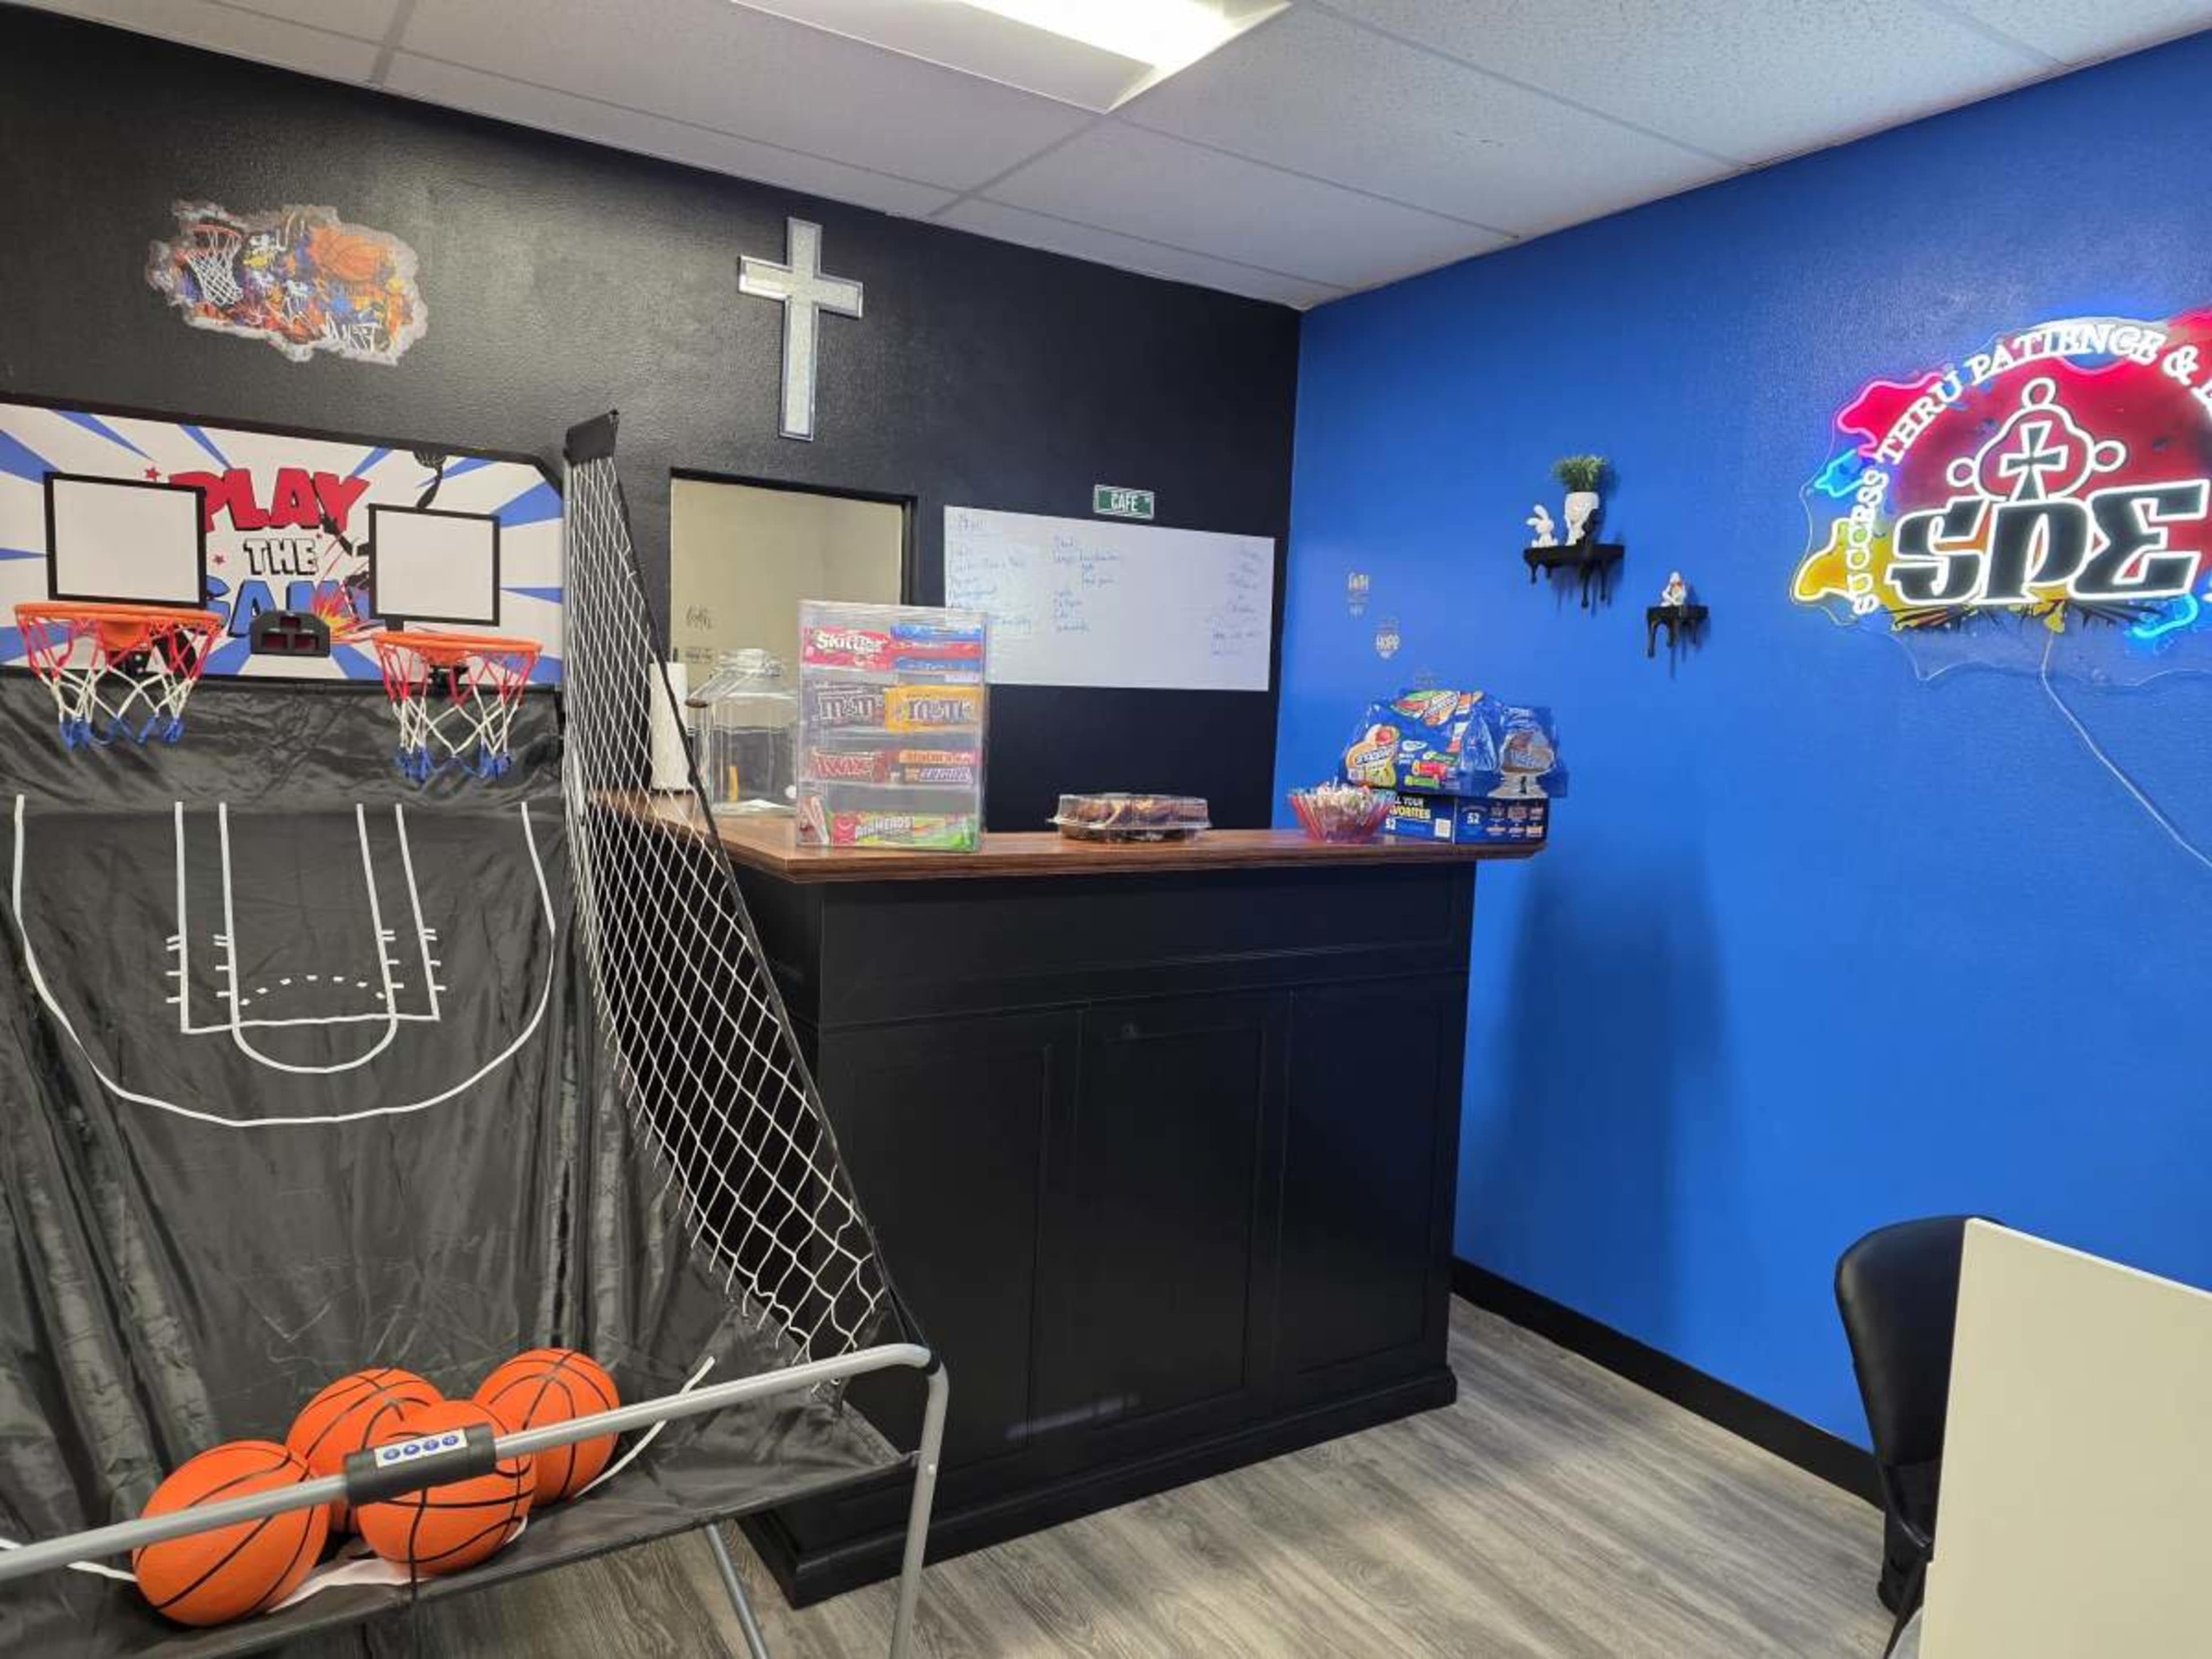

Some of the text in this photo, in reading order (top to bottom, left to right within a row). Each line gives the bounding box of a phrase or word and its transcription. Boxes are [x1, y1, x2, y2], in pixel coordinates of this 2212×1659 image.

[1842, 321, 2200, 615] SUCCESS THRU PATIENCE &
[169, 468, 371, 532] PLAY
[1110, 492, 1139, 513] CAFE
[244, 537, 319, 575] THE
[1467, 812, 1480, 824] 52
